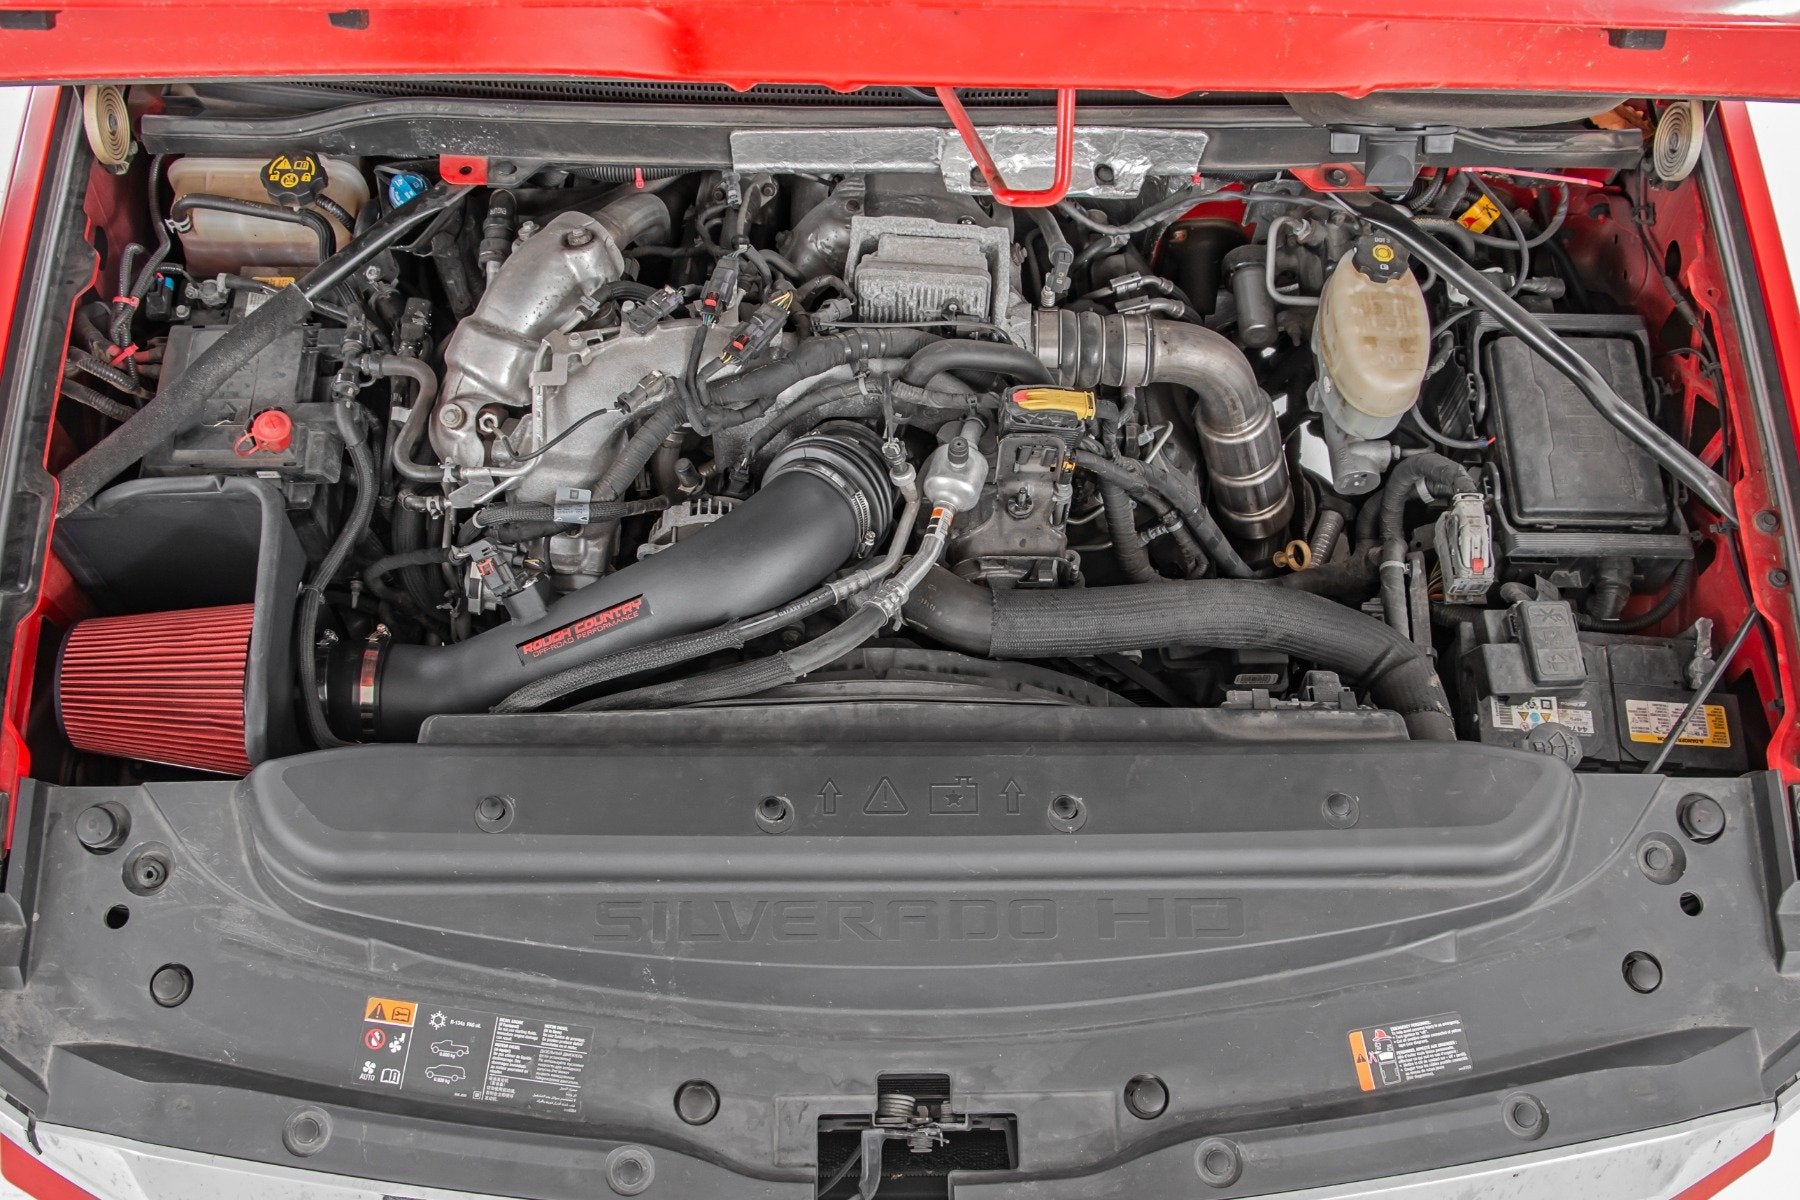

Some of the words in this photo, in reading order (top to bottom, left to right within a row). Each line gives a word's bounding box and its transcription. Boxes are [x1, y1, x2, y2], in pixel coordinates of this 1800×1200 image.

[523, 627, 572, 655] ROUGH
[575, 598, 643, 634] COUNTRY
[532, 637, 574, 658] OFF-ROAD
[576, 610, 640, 640] PERFORMANCE
[593, 897, 1060, 943] SILVERADO
[1096, 896, 1248, 940] HD
[358, 1072, 376, 1082] AUTO
